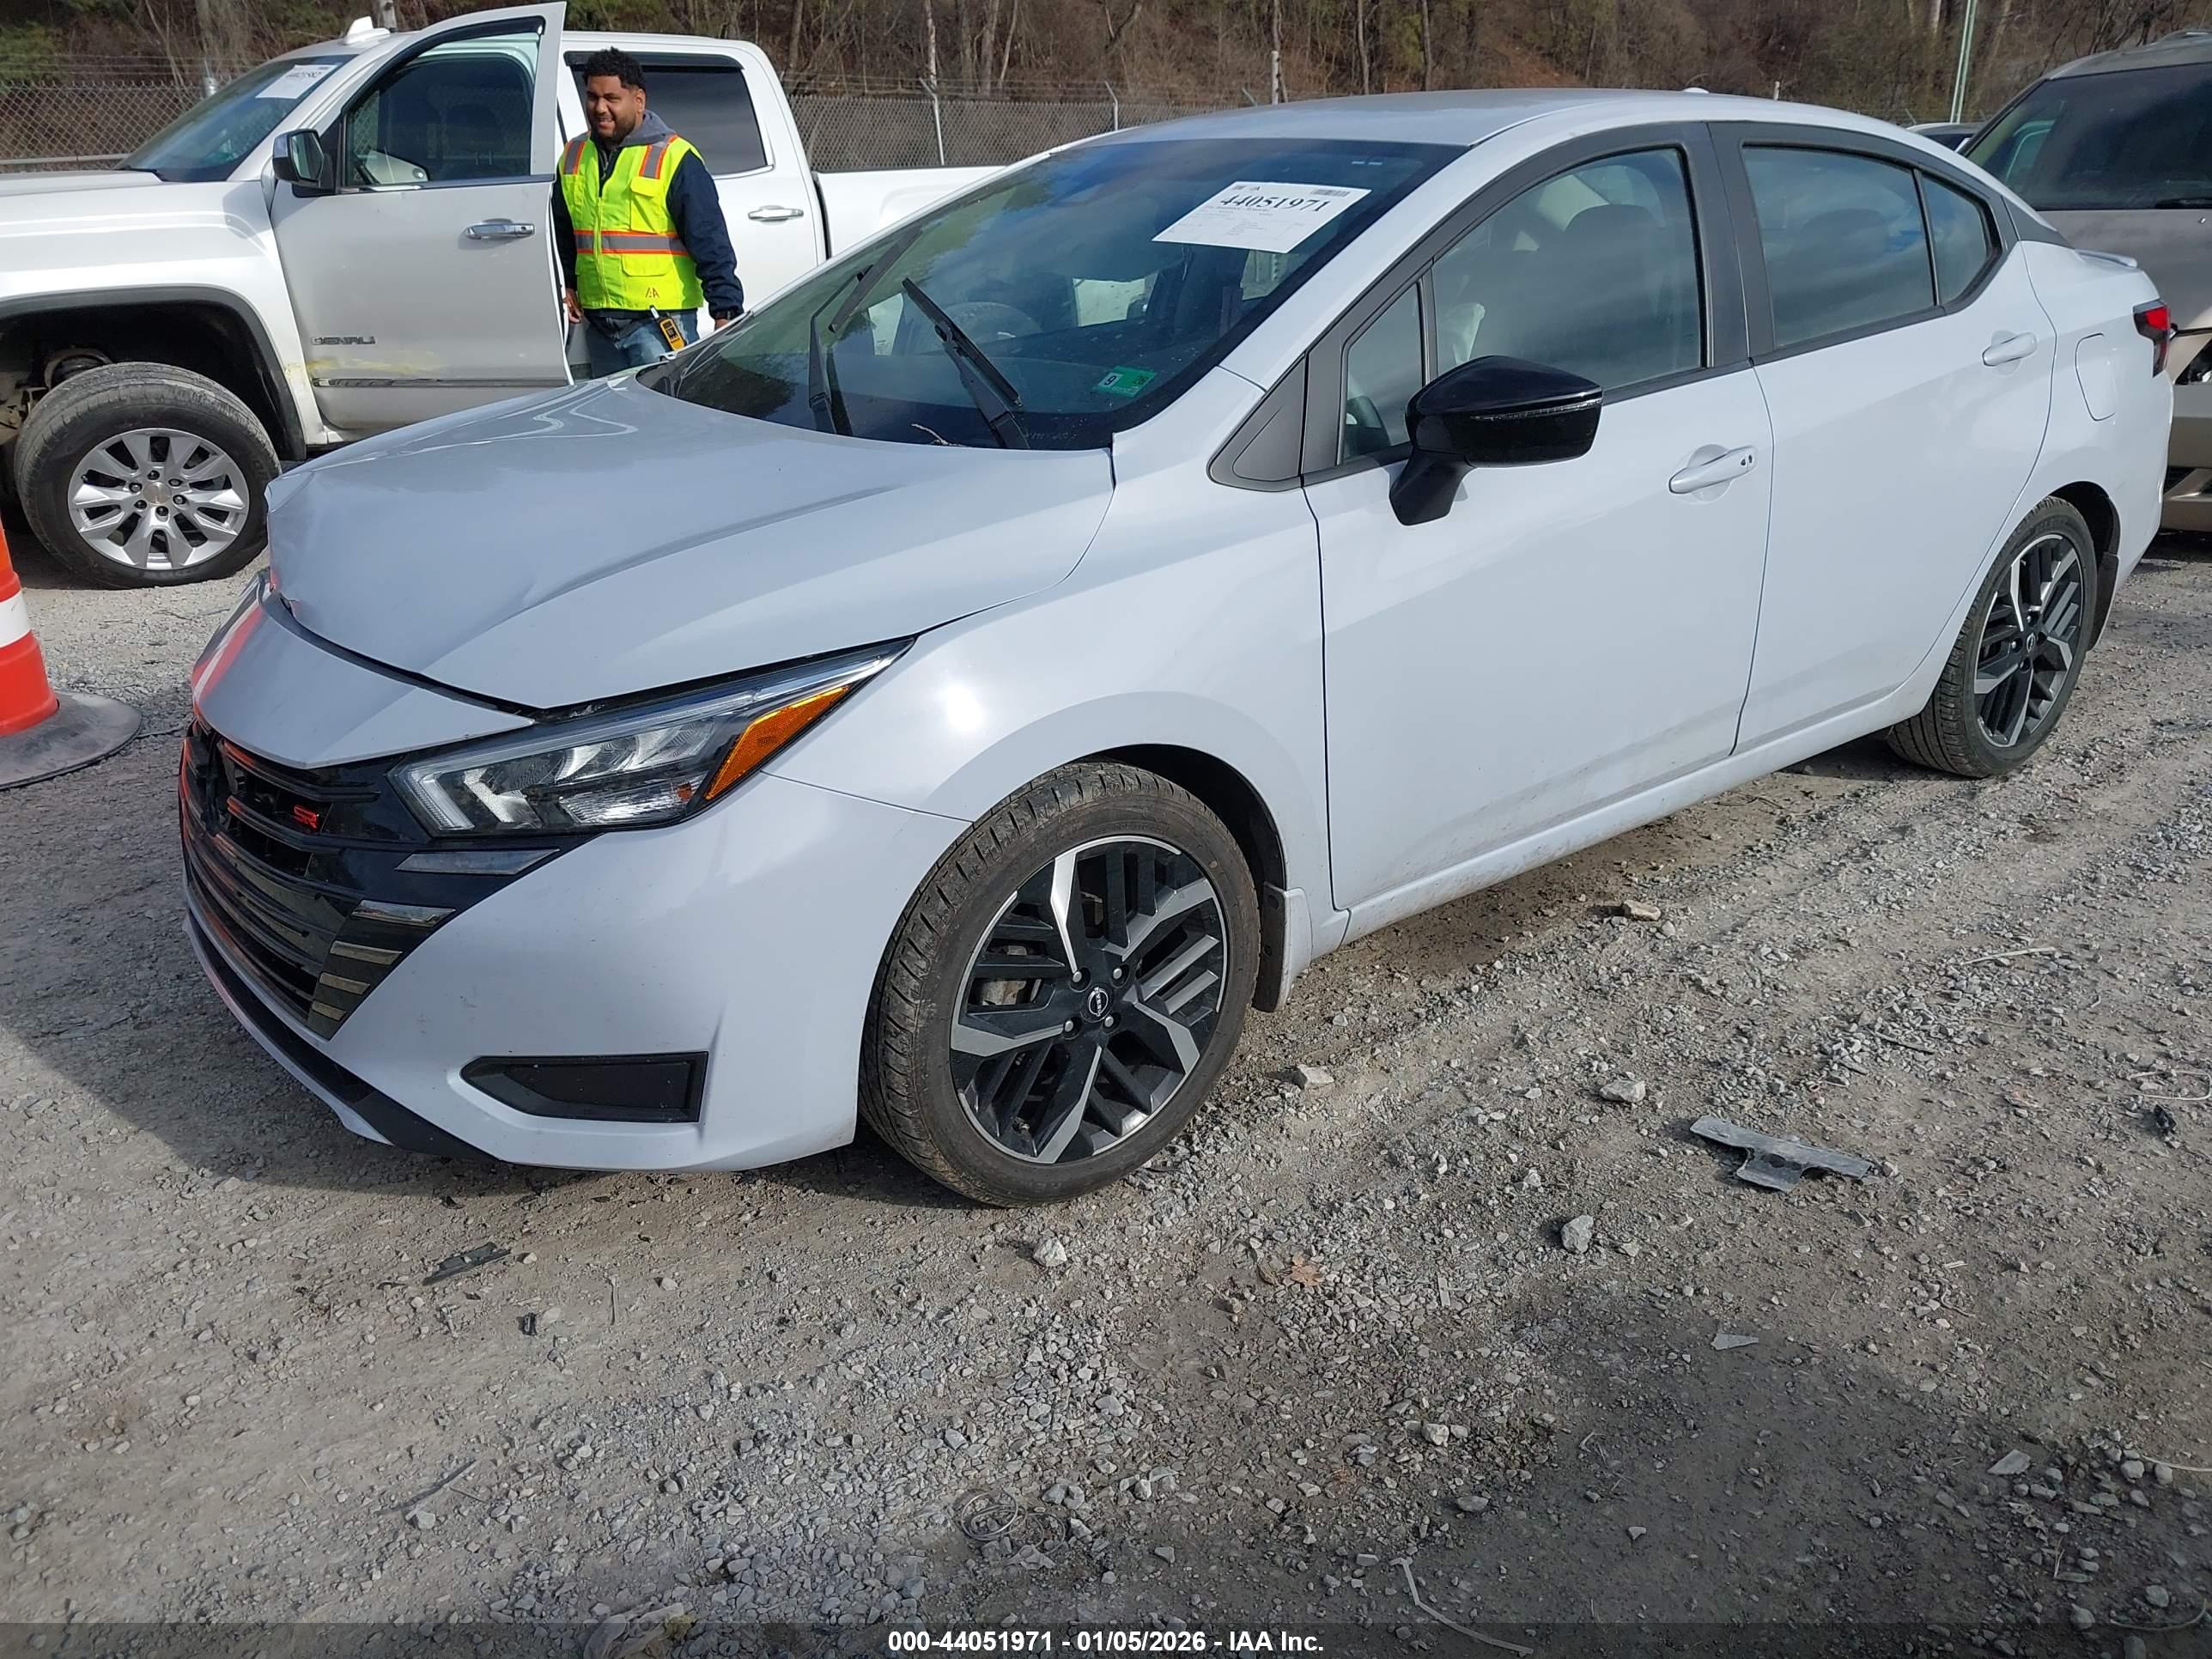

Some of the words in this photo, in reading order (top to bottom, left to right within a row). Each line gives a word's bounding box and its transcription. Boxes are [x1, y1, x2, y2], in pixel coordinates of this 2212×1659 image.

[1220, 195, 1330, 211] 44051971
[311, 337, 376, 345] DENALI
[294, 805, 317, 829] SR
[1093, 987, 1102, 1018] NISSAN
